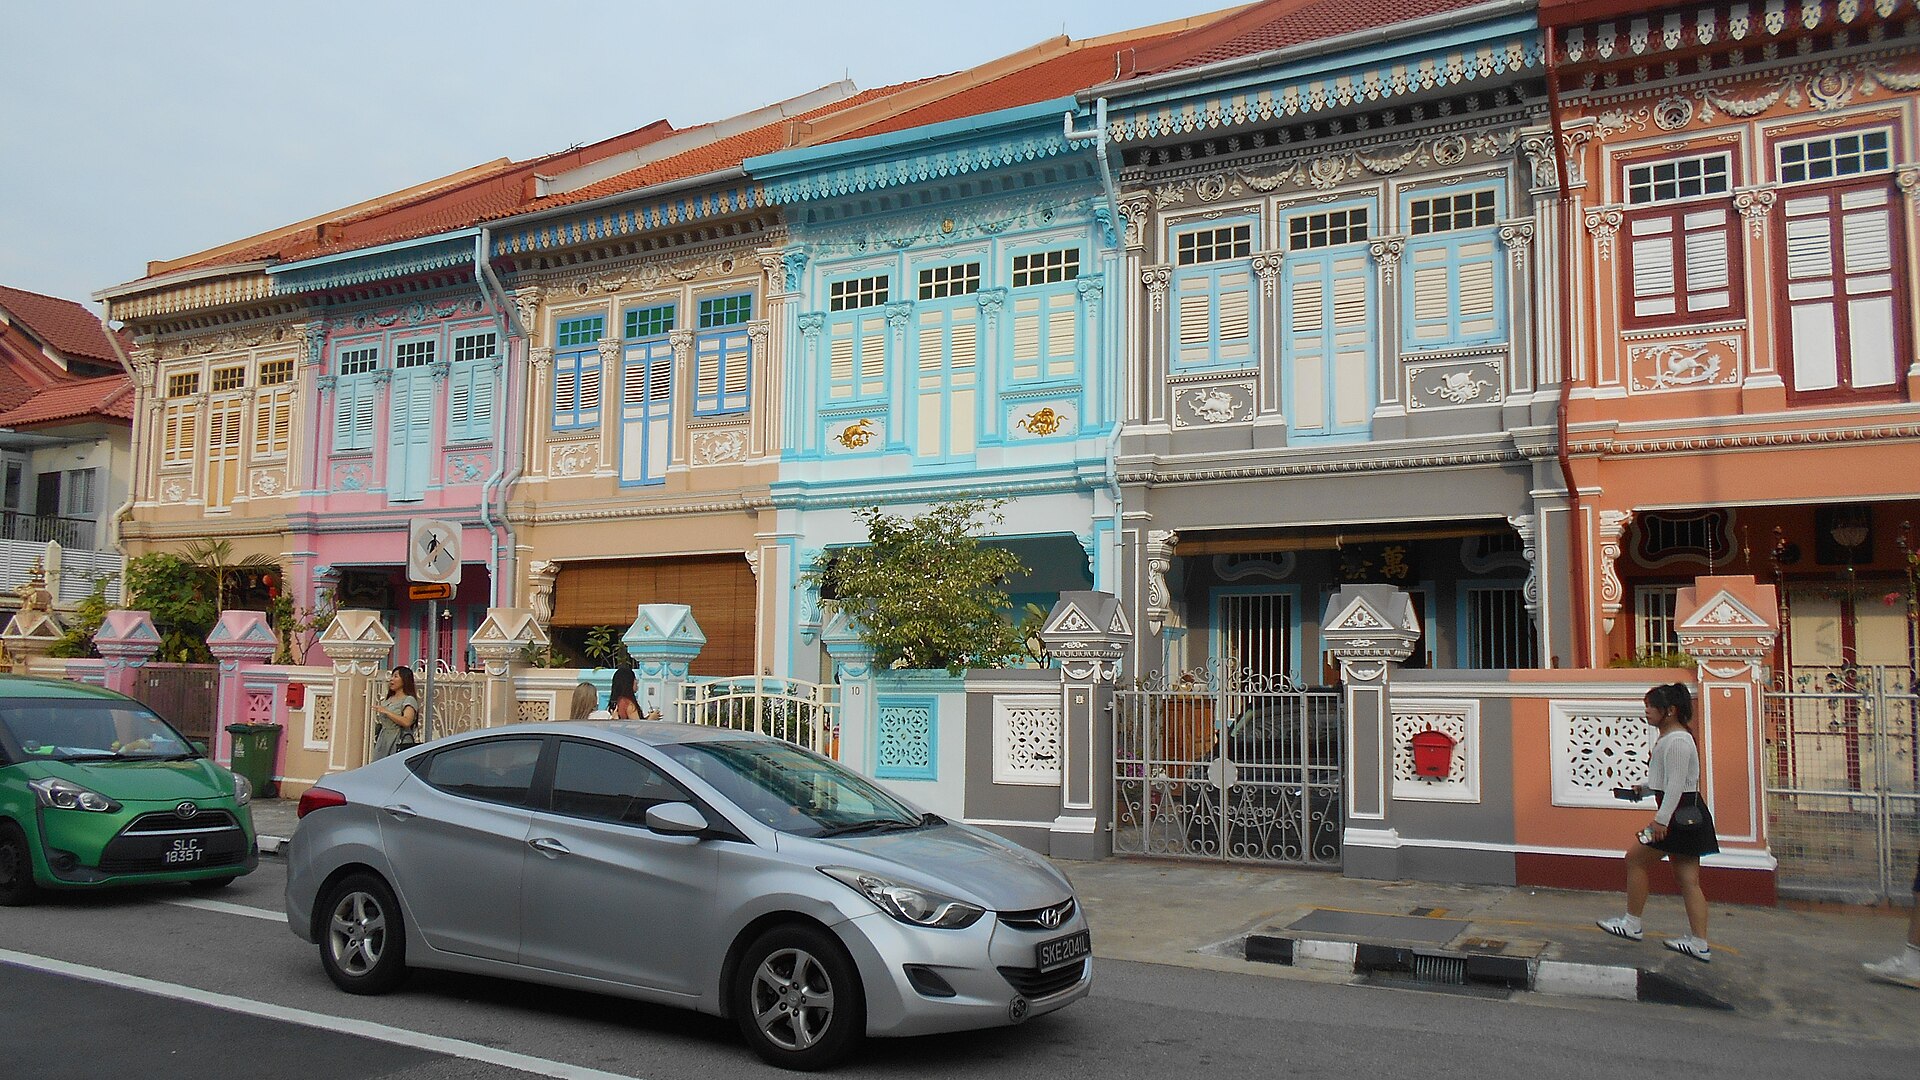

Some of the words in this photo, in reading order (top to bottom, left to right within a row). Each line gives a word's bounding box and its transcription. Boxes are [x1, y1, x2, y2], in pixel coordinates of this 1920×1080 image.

[851, 686, 861, 696] 10
[173, 838, 198, 851] SLC
[165, 848, 204, 863] 1835T
[1042, 935, 1088, 965] SKE2041L
